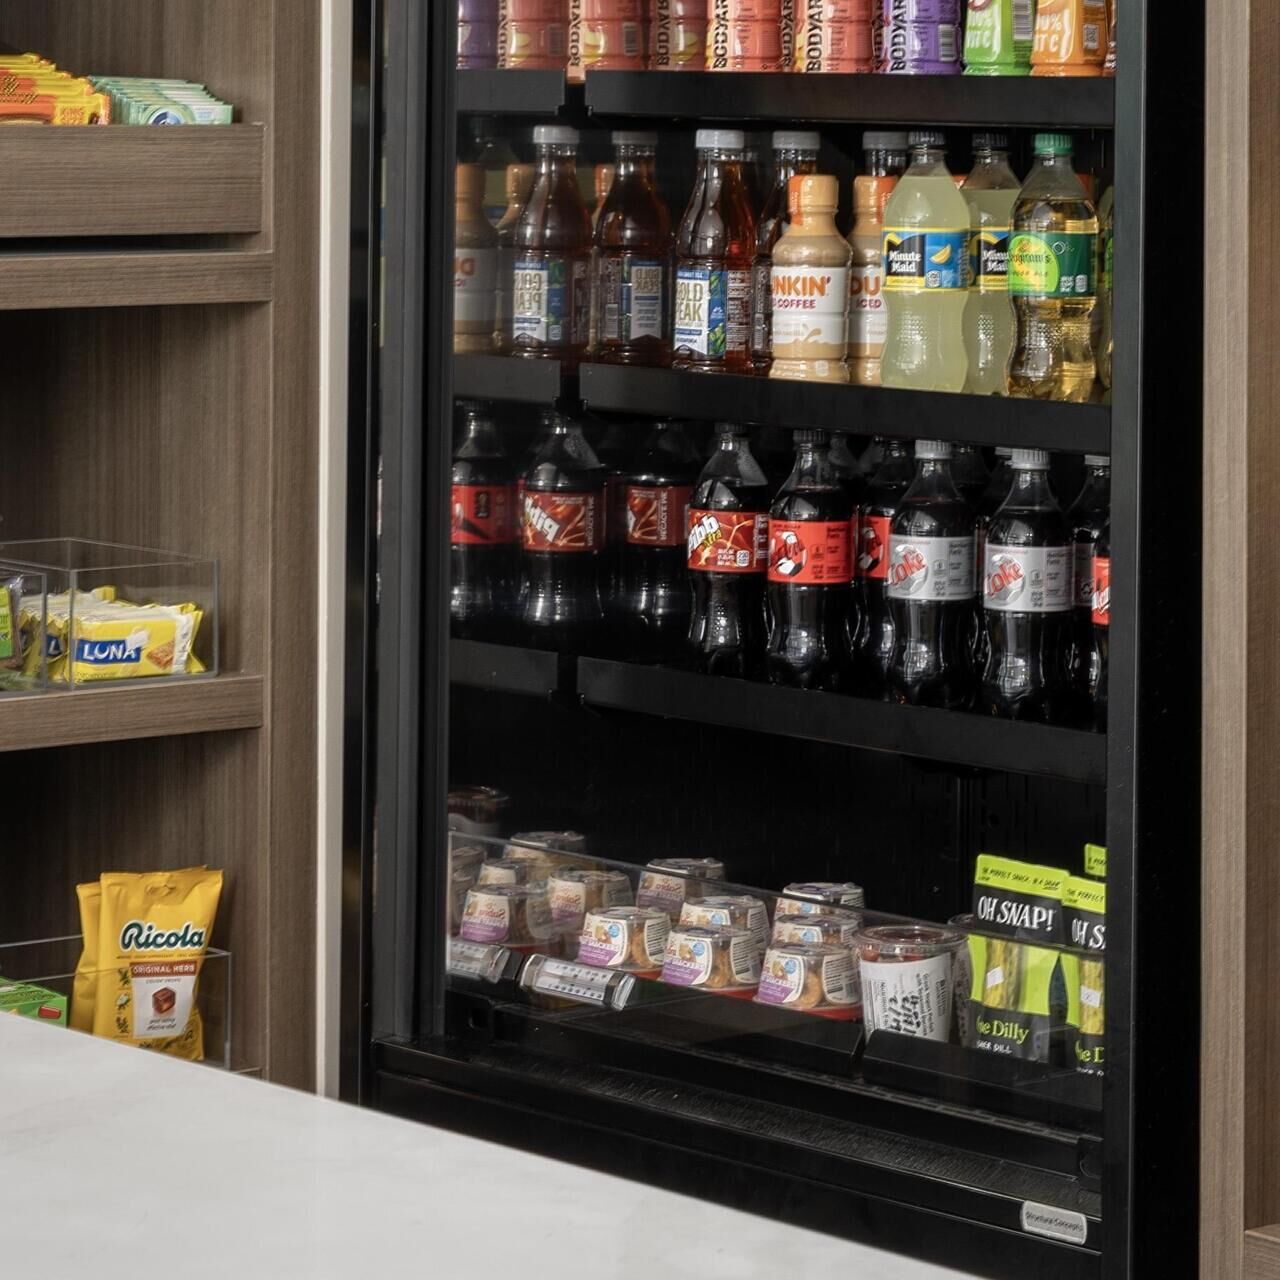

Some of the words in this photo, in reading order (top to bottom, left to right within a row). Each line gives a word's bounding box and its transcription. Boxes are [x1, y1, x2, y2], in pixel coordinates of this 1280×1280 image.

[888, 250, 922, 263] Minute
[891, 261, 916, 273] Maid
[888, 549, 928, 587] Coke
[82, 643, 137, 661] LUNA
[977, 894, 1000, 922] OH
[996, 899, 1057, 932] SNAP!
[120, 921, 205, 950] Ricola
[132, 964, 170, 974] ORIGINAL
[991, 1019, 1029, 1045] Dilly
